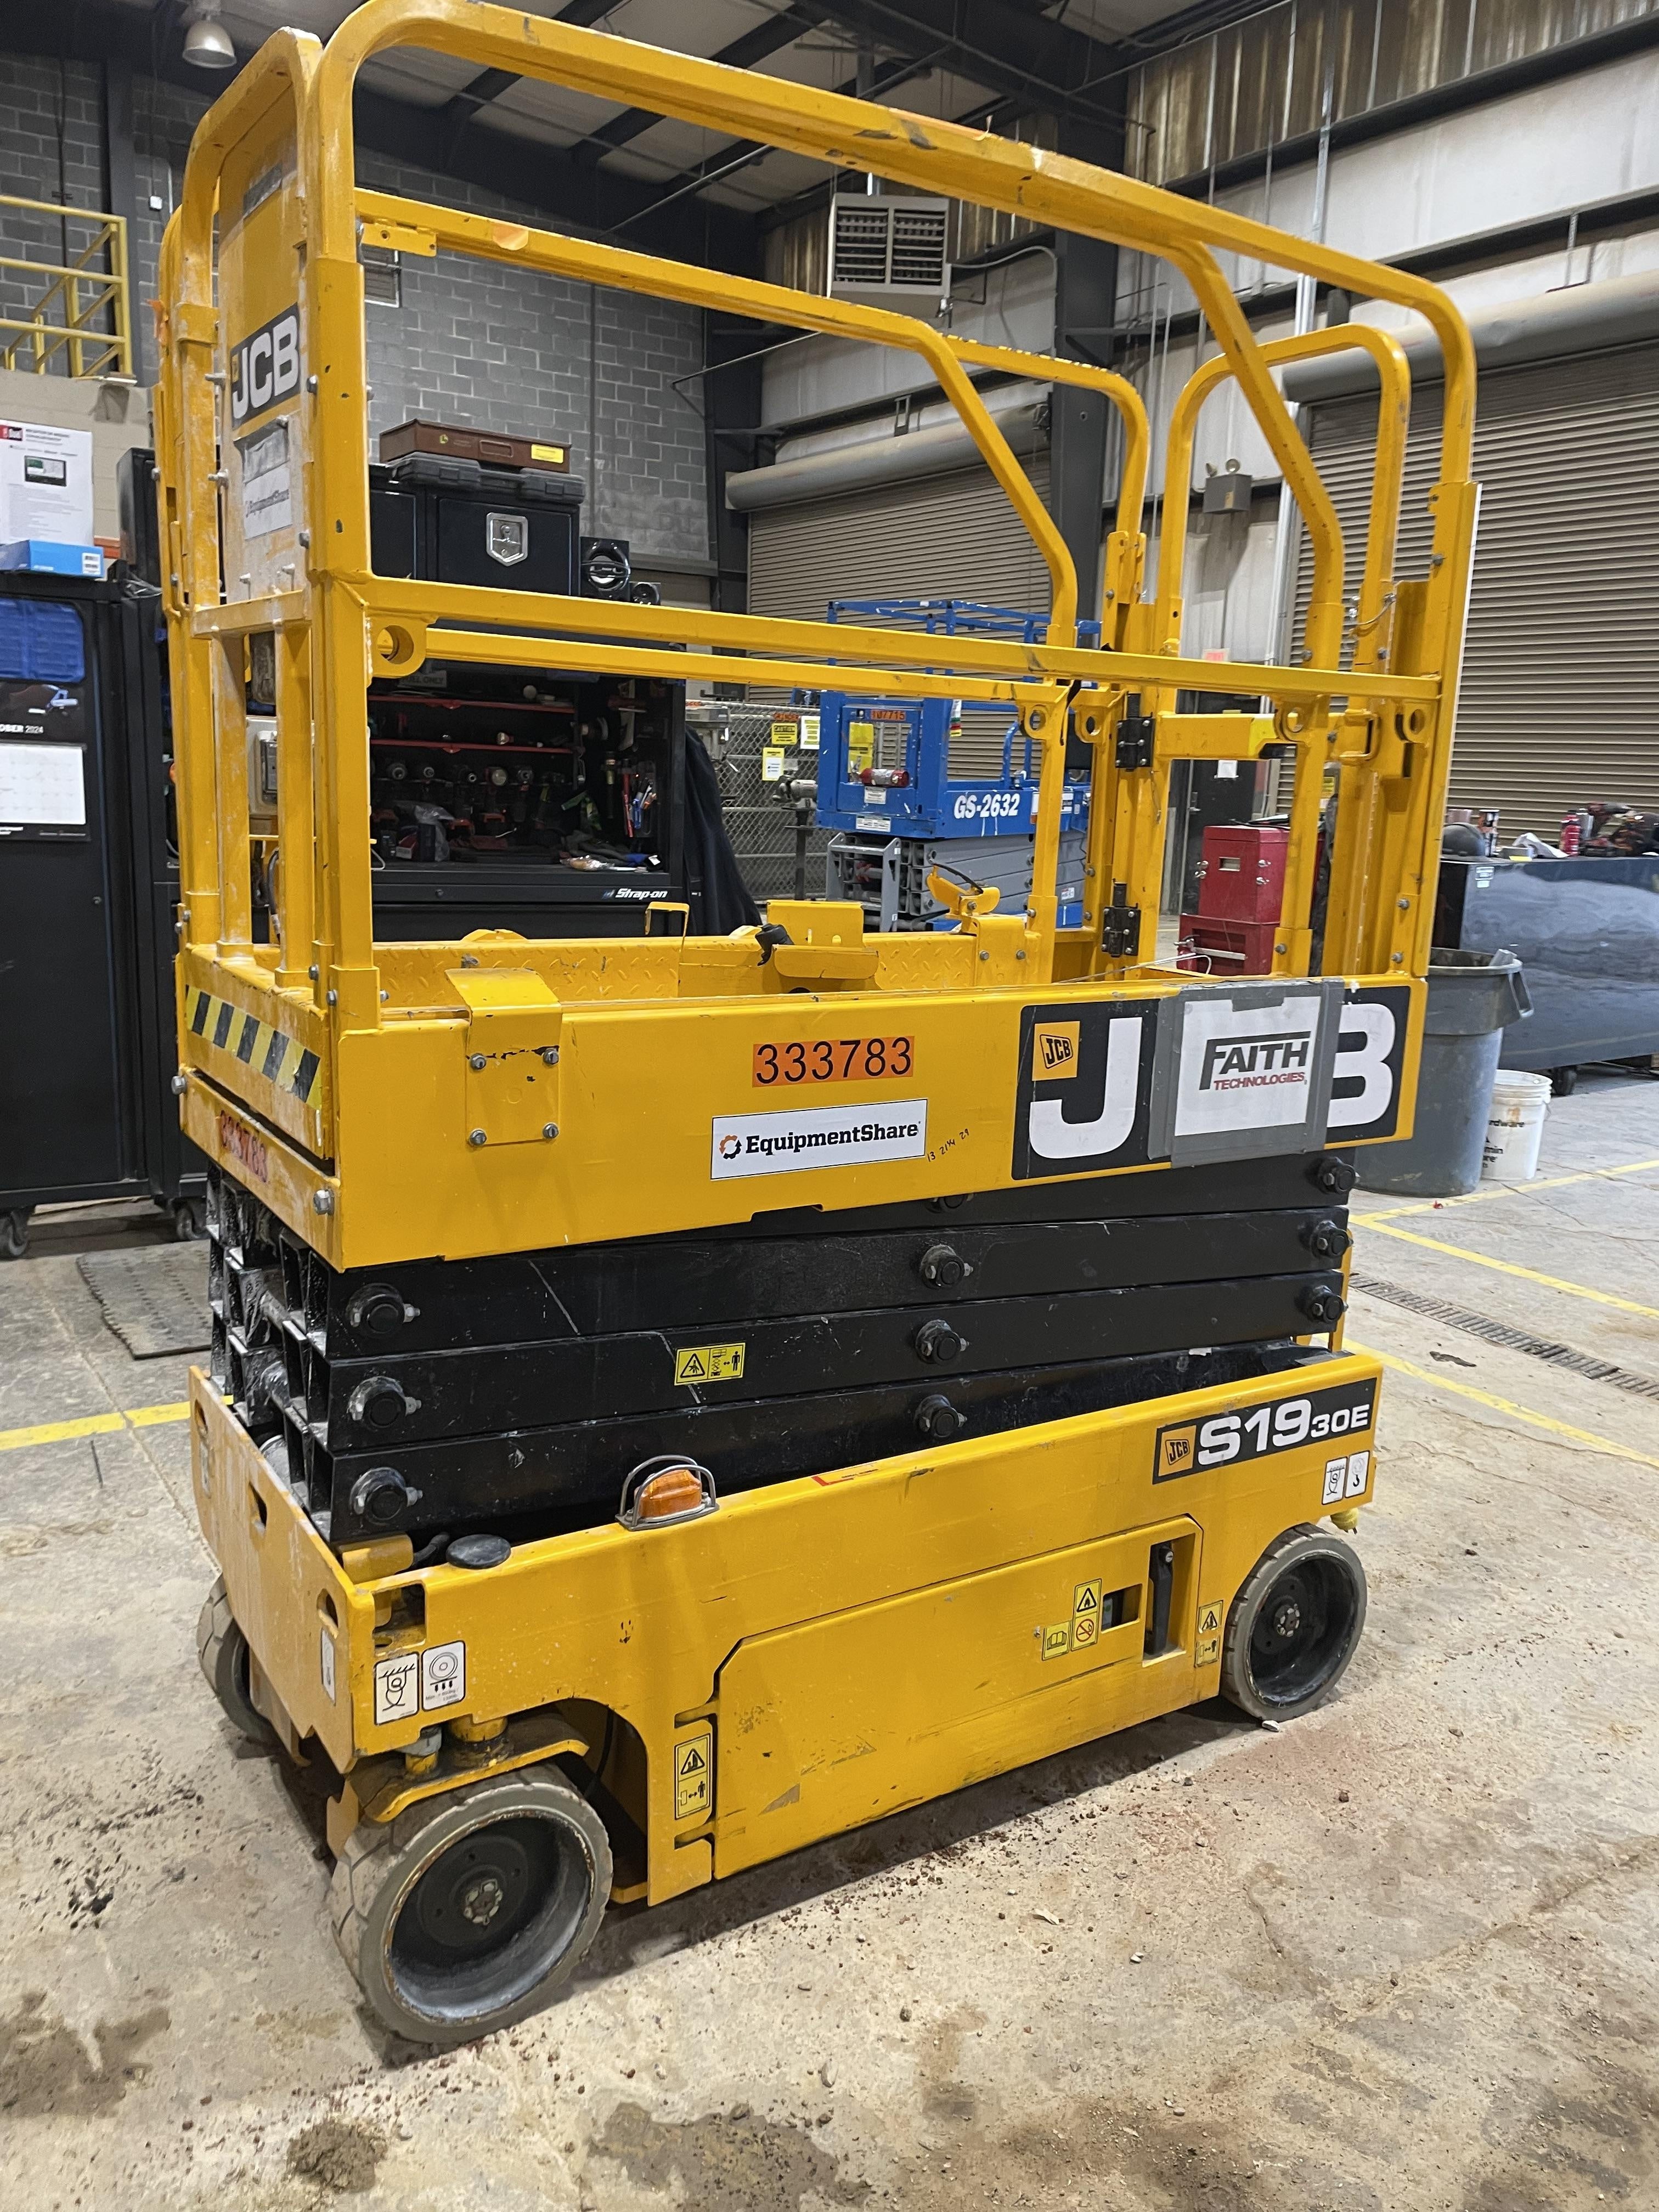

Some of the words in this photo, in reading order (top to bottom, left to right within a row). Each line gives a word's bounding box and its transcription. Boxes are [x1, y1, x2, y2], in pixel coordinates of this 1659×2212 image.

[233, 315, 298, 419] JCB
[25, 725, 44, 734] 2024
[953, 793, 1020, 819] GS-2632
[615, 888, 668, 900] Strap-on
[756, 1037, 911, 1085] 333783
[1044, 1036, 1073, 1067] JCB
[1199, 1031, 1311, 1091] FAITH
[1029, 1003, 1396, 1159] JB
[1213, 1071, 1306, 1091] TECHNOLOGIES
[746, 1122, 919, 1156] EquipmentShare
[927, 1151, 936, 1162] 13
[1169, 1438, 1189, 1462] JCB
